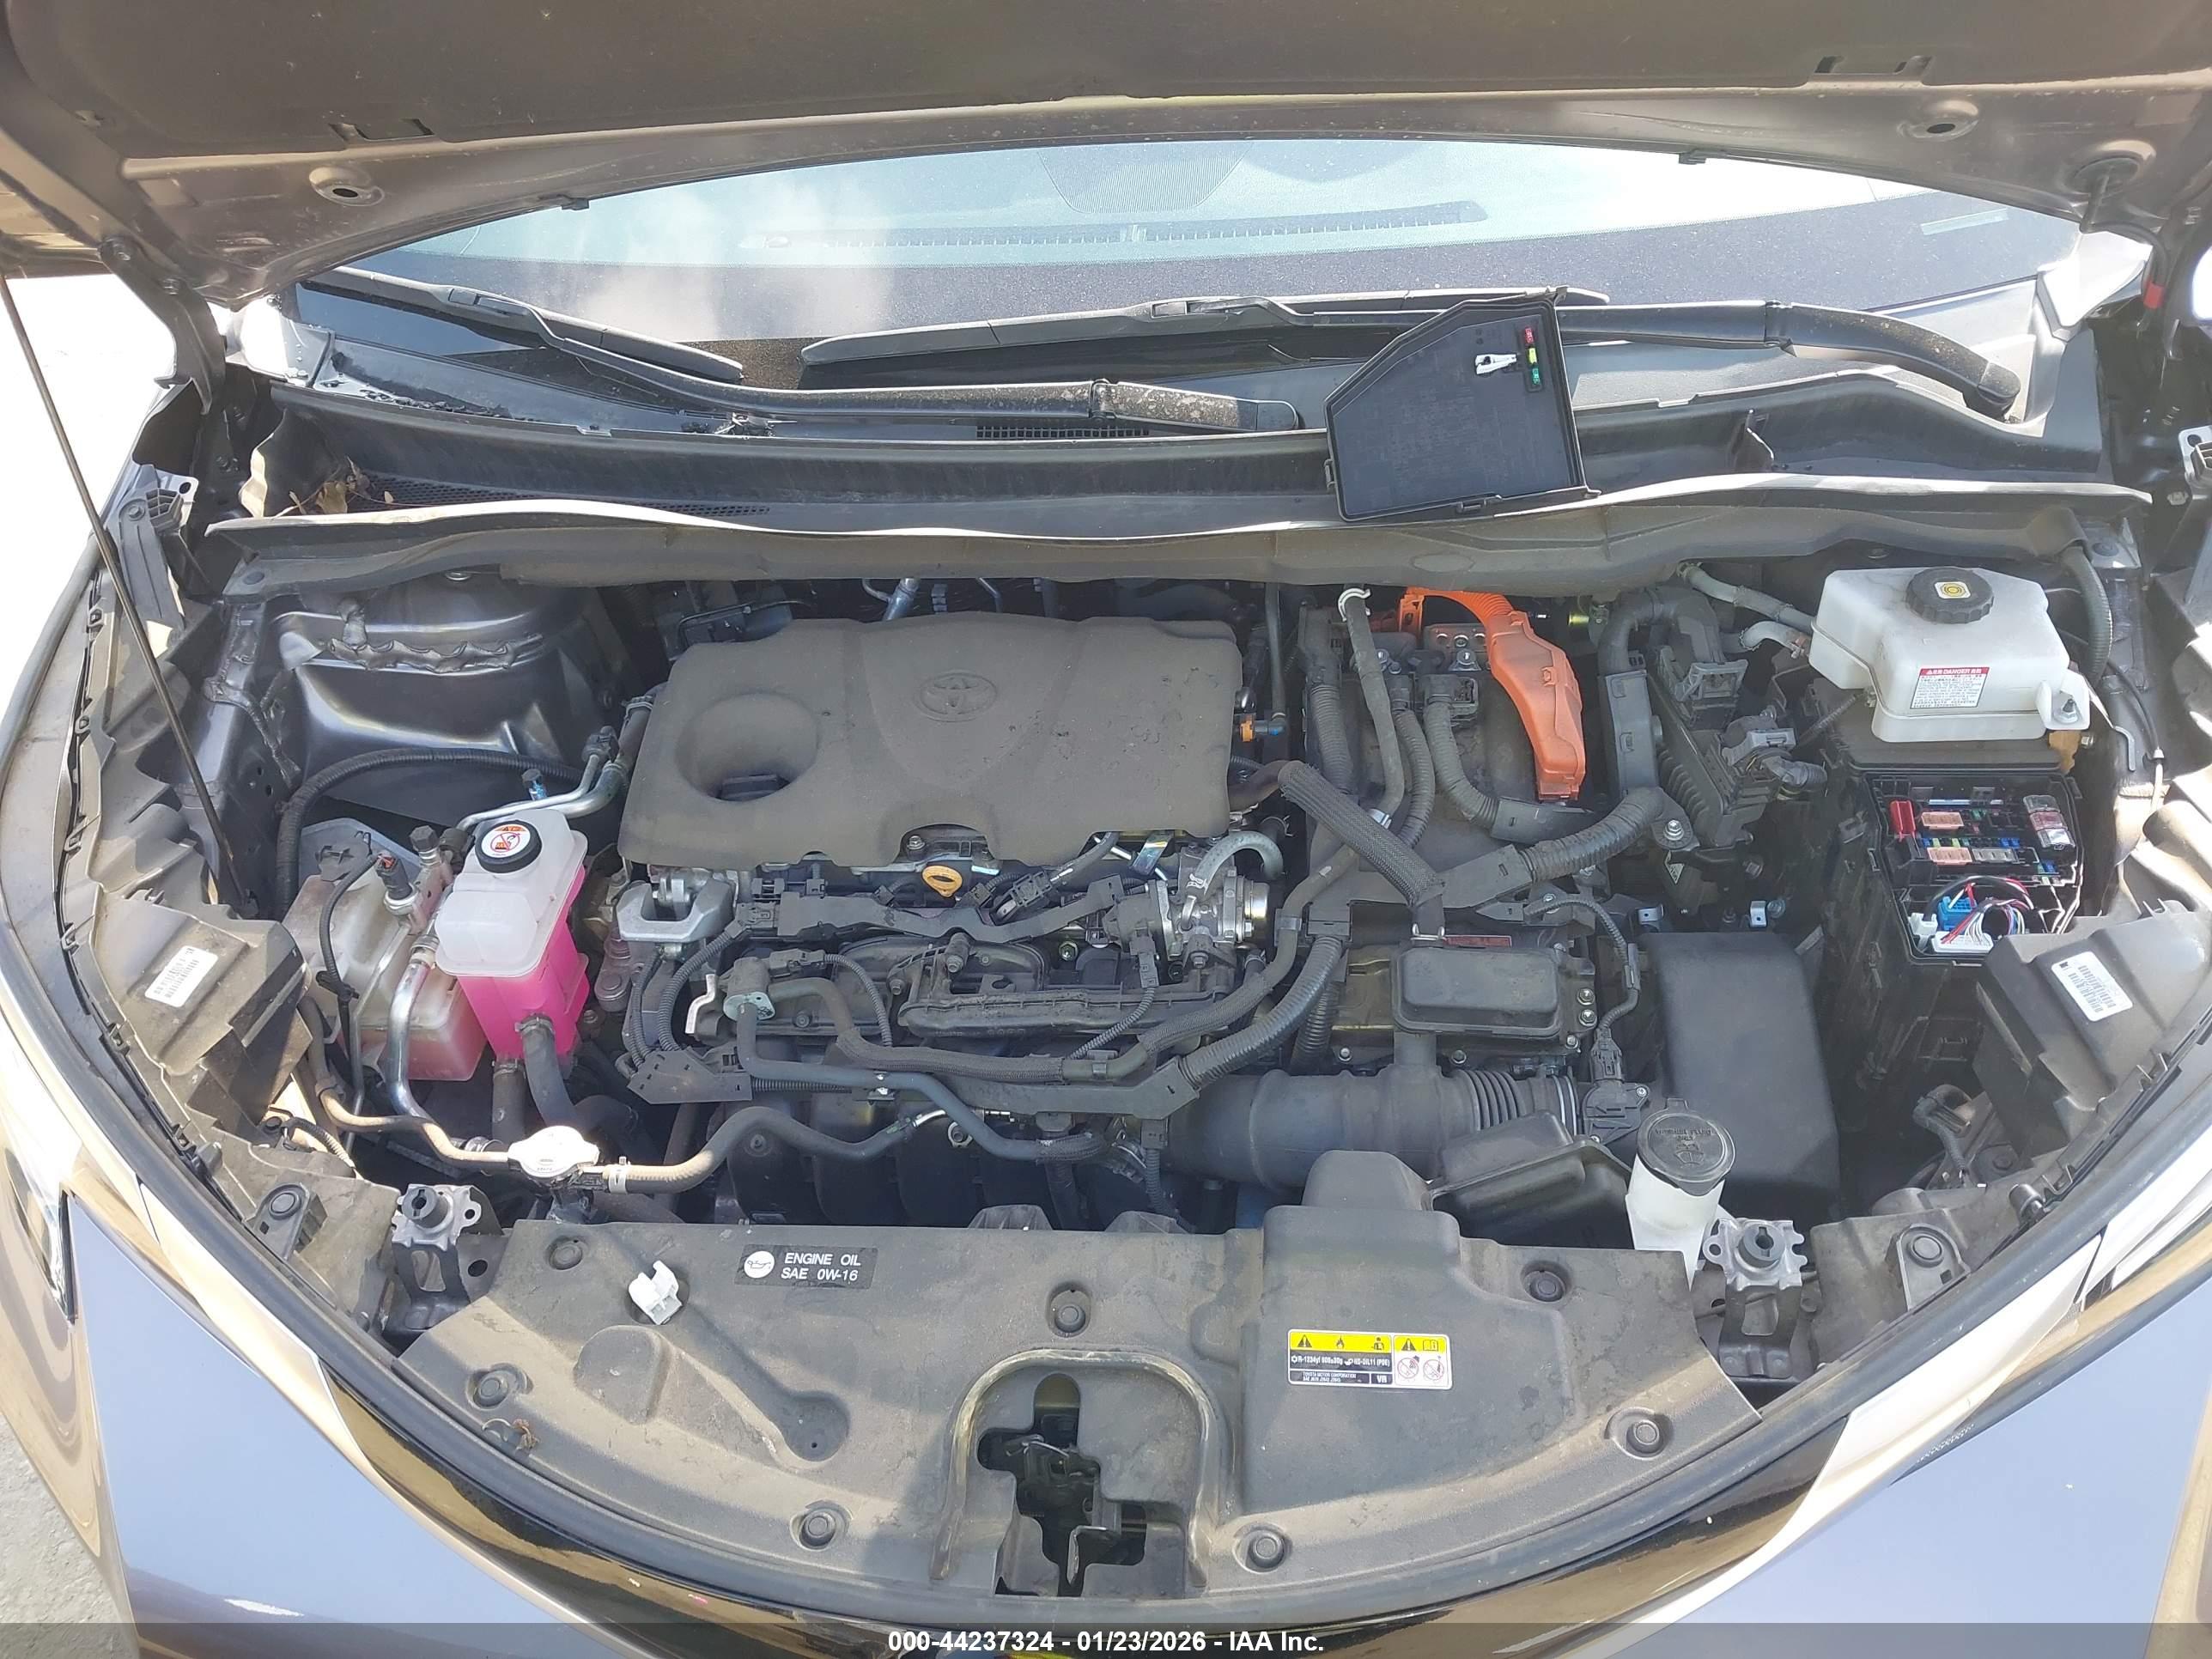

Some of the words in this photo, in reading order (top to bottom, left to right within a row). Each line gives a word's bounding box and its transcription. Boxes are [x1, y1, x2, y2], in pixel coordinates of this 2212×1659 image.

[784, 1252, 833, 1266] ENGINE
[840, 1254, 861, 1267] OIL
[781, 1267, 809, 1279] SAE
[817, 1268, 859, 1281] 0W-16
